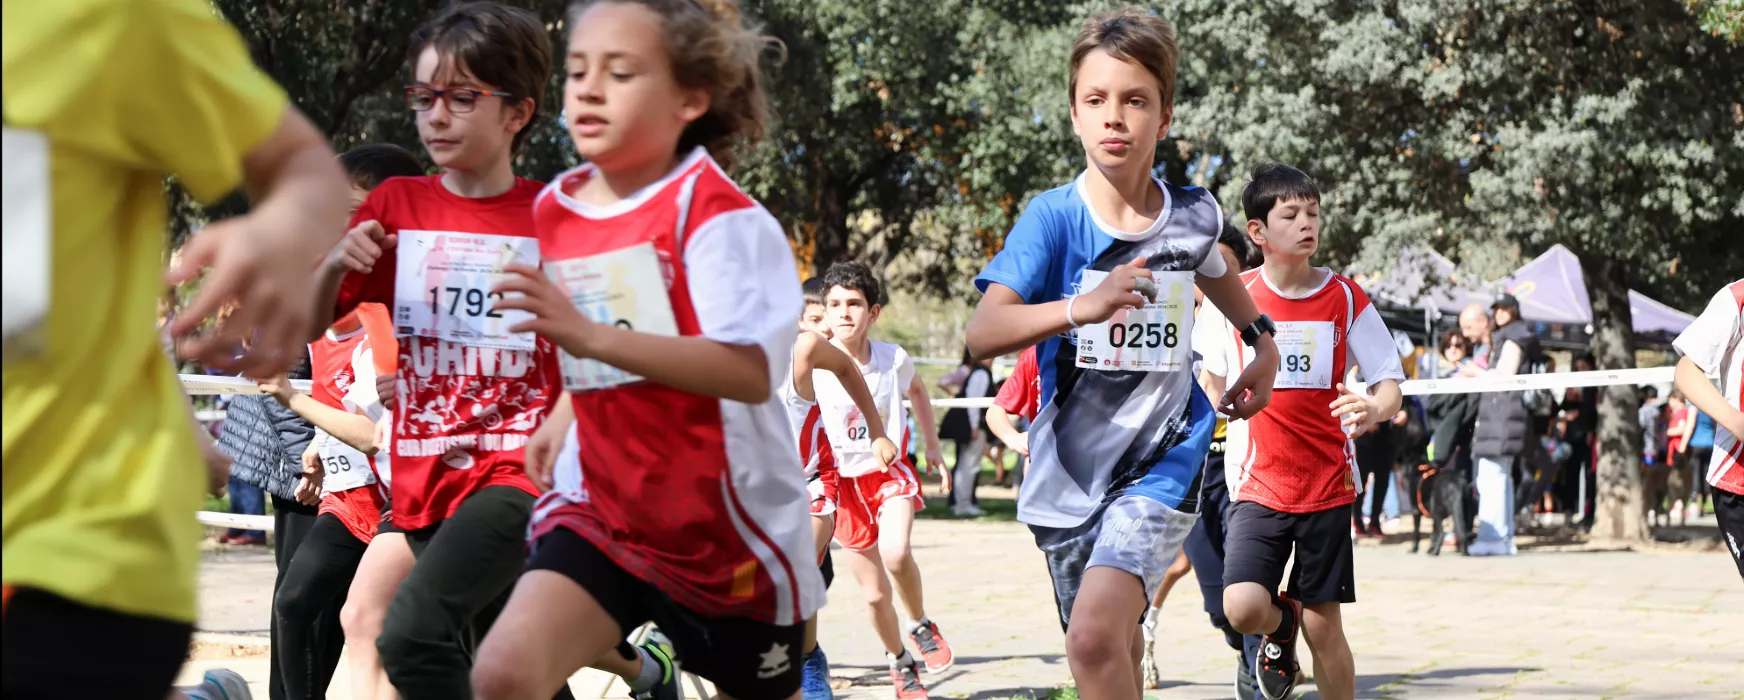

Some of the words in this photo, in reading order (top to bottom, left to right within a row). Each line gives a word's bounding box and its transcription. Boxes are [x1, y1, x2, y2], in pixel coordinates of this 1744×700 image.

[429, 285, 505, 318] 1792
[1109, 322, 1178, 348] 0258
[848, 426, 867, 441] 02
[322, 455, 351, 474] 59
